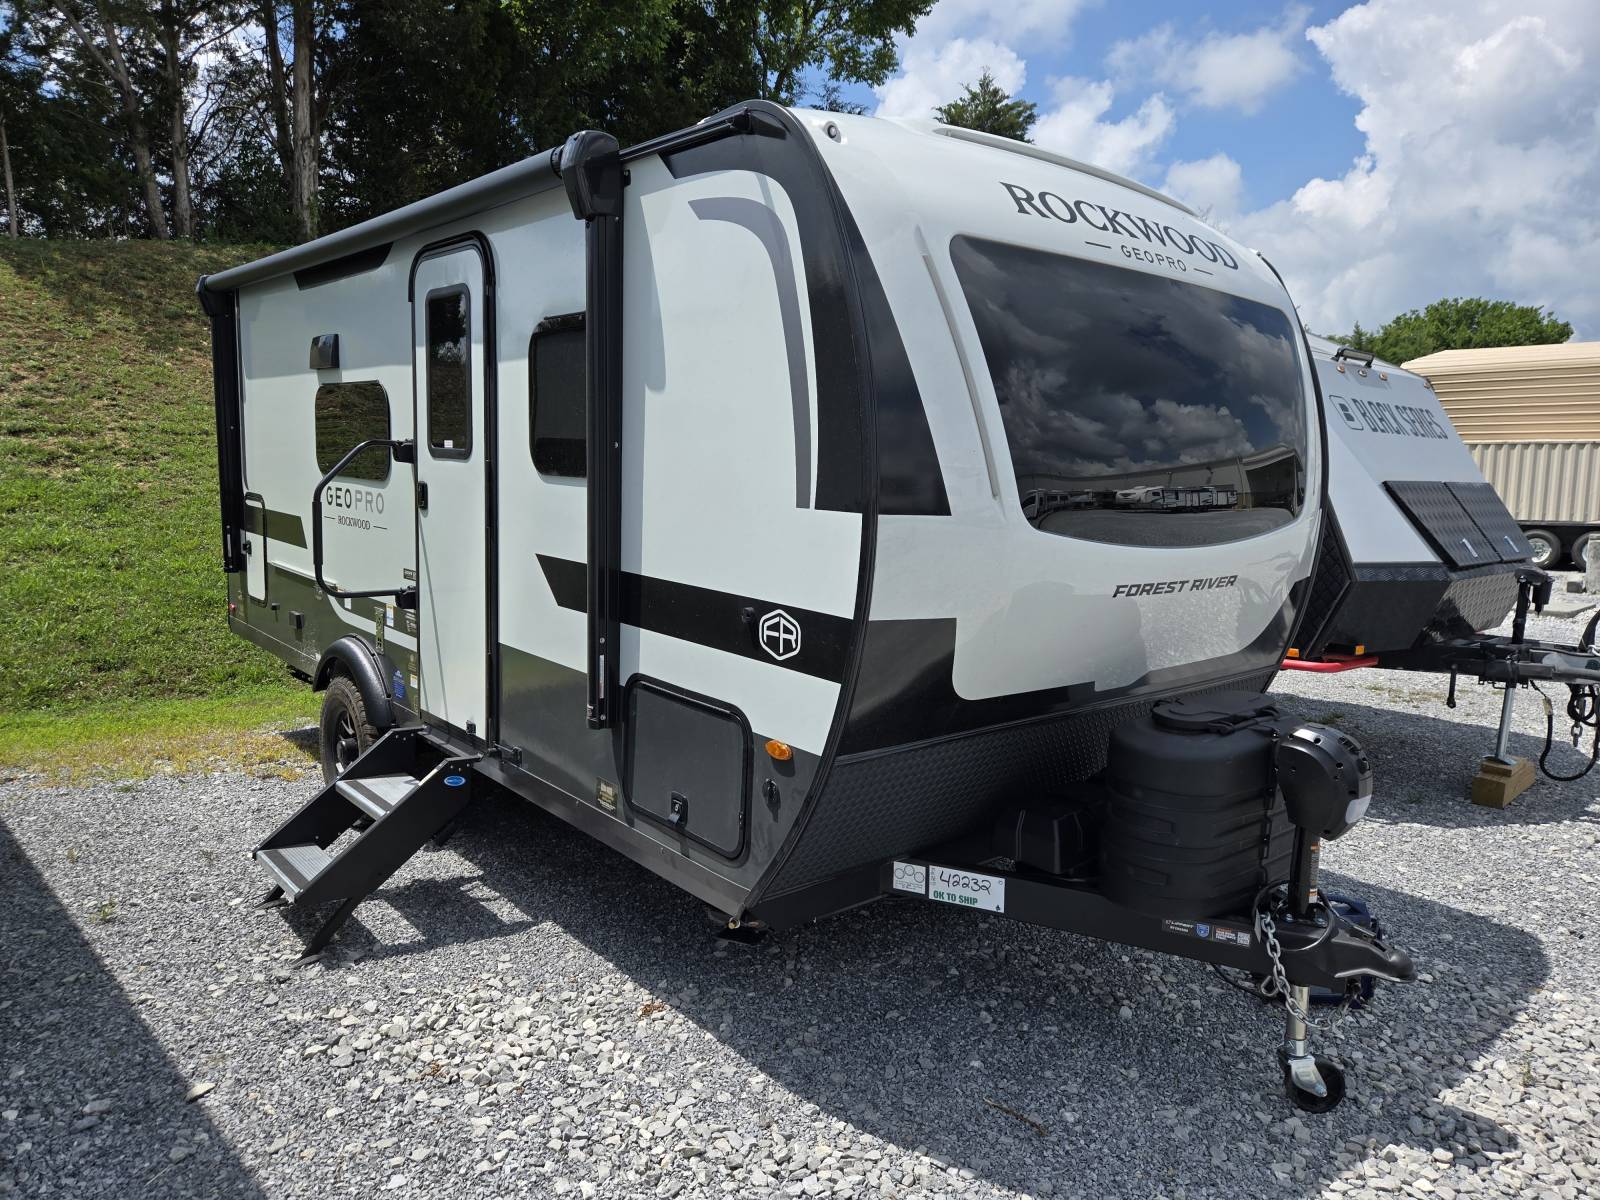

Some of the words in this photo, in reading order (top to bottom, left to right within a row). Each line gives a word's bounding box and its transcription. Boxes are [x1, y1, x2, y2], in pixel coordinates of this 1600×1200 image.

[999, 181, 1239, 271] ROCKWOOD
[1120, 244, 1187, 273] GEOPRO
[1351, 398, 1409, 437] BLACK
[1395, 404, 1449, 440] SERIES
[337, 515, 371, 530] ROCKWOOD
[1111, 580, 1190, 598] FOREST
[1189, 574, 1239, 592] RIVER
[940, 870, 992, 895] 42232
[933, 890, 945, 900] OK
[946, 892, 957, 902] TO
[958, 895, 978, 906] SHIP
